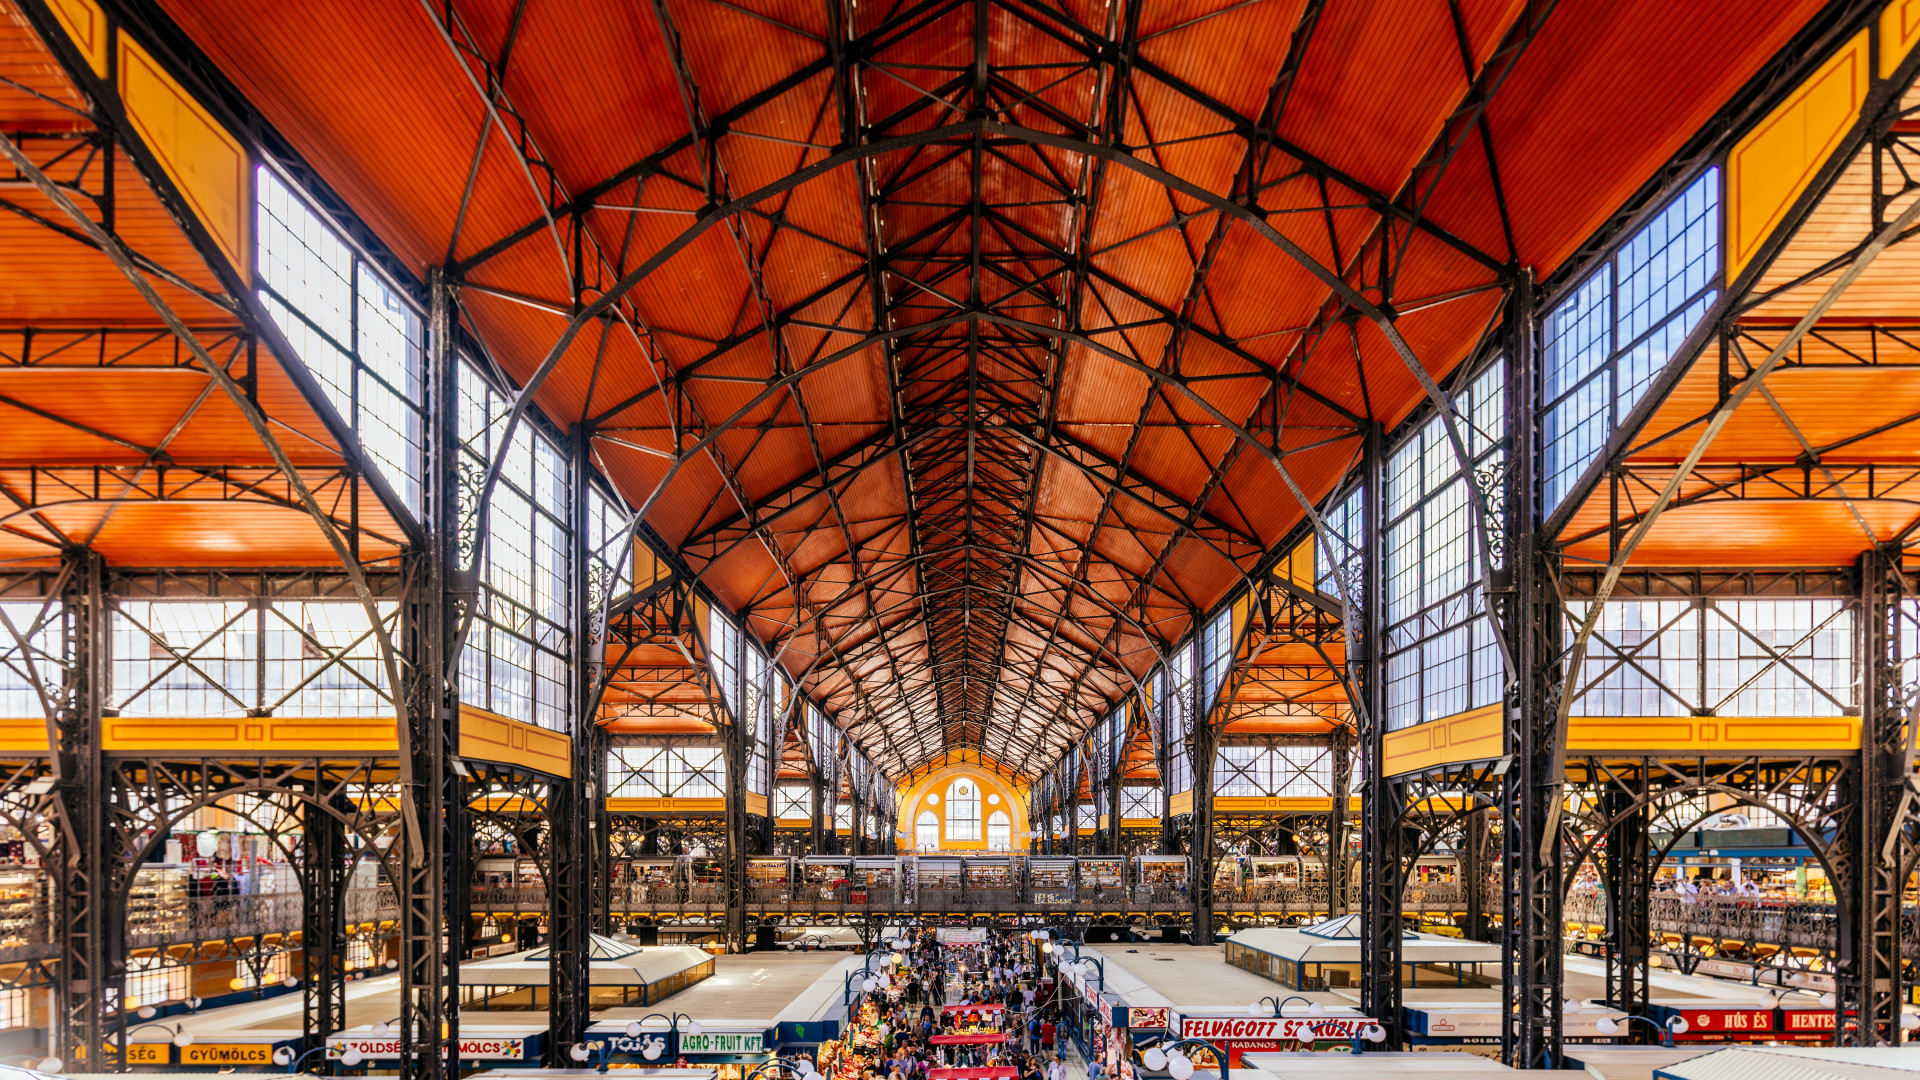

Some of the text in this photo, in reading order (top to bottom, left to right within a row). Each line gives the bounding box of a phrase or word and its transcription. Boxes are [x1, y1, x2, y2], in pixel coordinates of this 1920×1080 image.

[1184, 1018, 1279, 1037] FELVÁGOTT
[1724, 1011, 1748, 1028] HÚS
[1753, 1011, 1767, 1028] ÉS
[1792, 1013, 1836, 1028] HENTES
[350, 1039, 401, 1054] ZÖLDSÉ
[682, 1034, 763, 1051] AGRO-FRUIT KFT.
[1231, 1041, 1277, 1050] KABANOS
